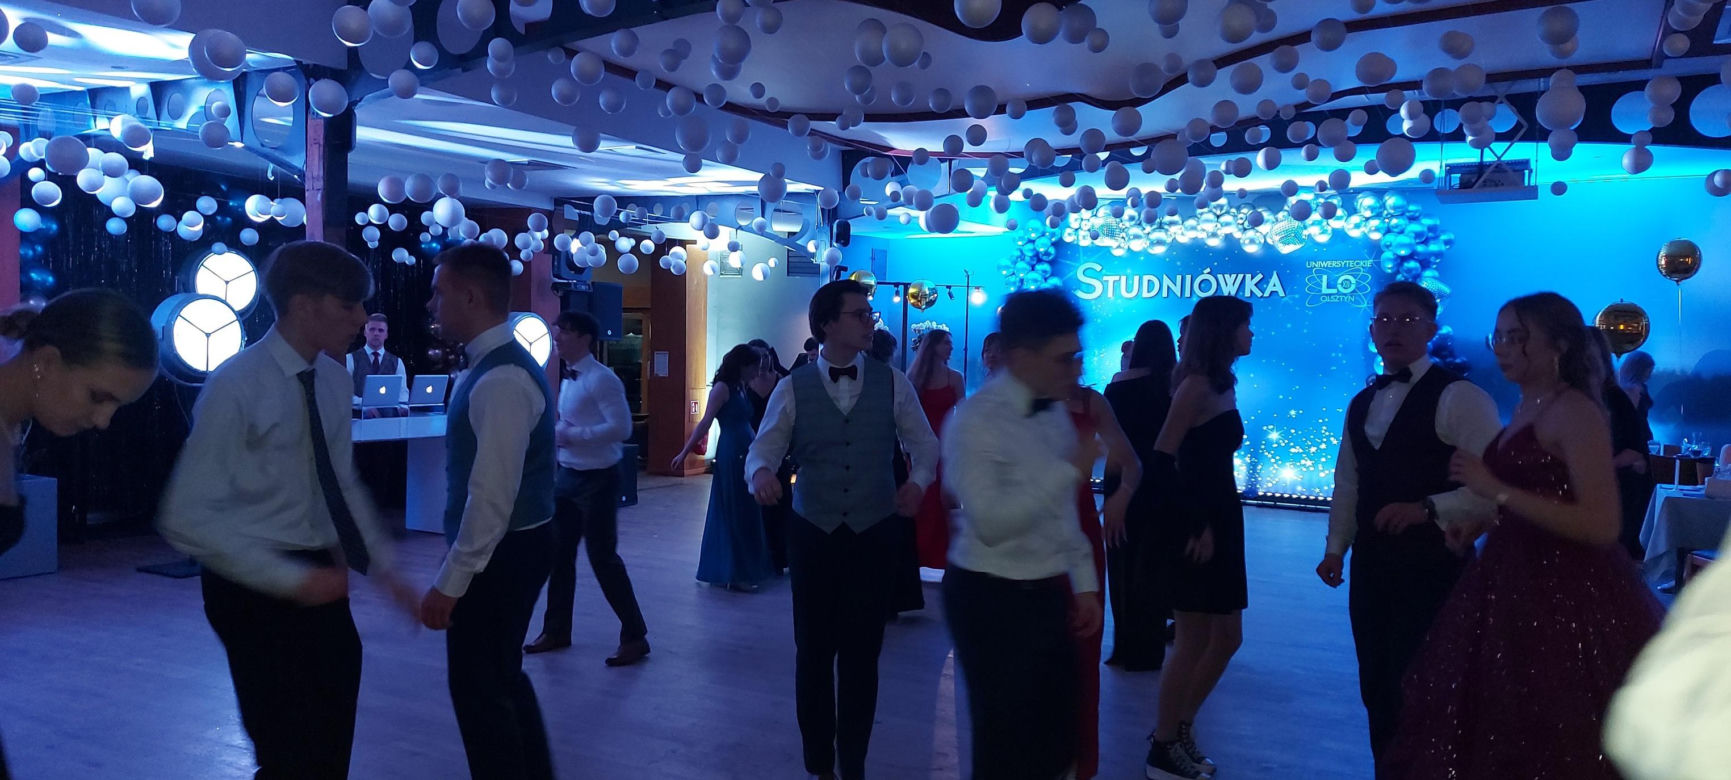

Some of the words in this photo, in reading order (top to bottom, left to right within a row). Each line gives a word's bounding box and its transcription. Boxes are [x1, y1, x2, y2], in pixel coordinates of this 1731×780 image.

[1306, 260, 1373, 268] UNIWERSYTECKIE
[1073, 262, 1286, 300] STUDNIÓWKA
[1322, 275, 1356, 293] LO
